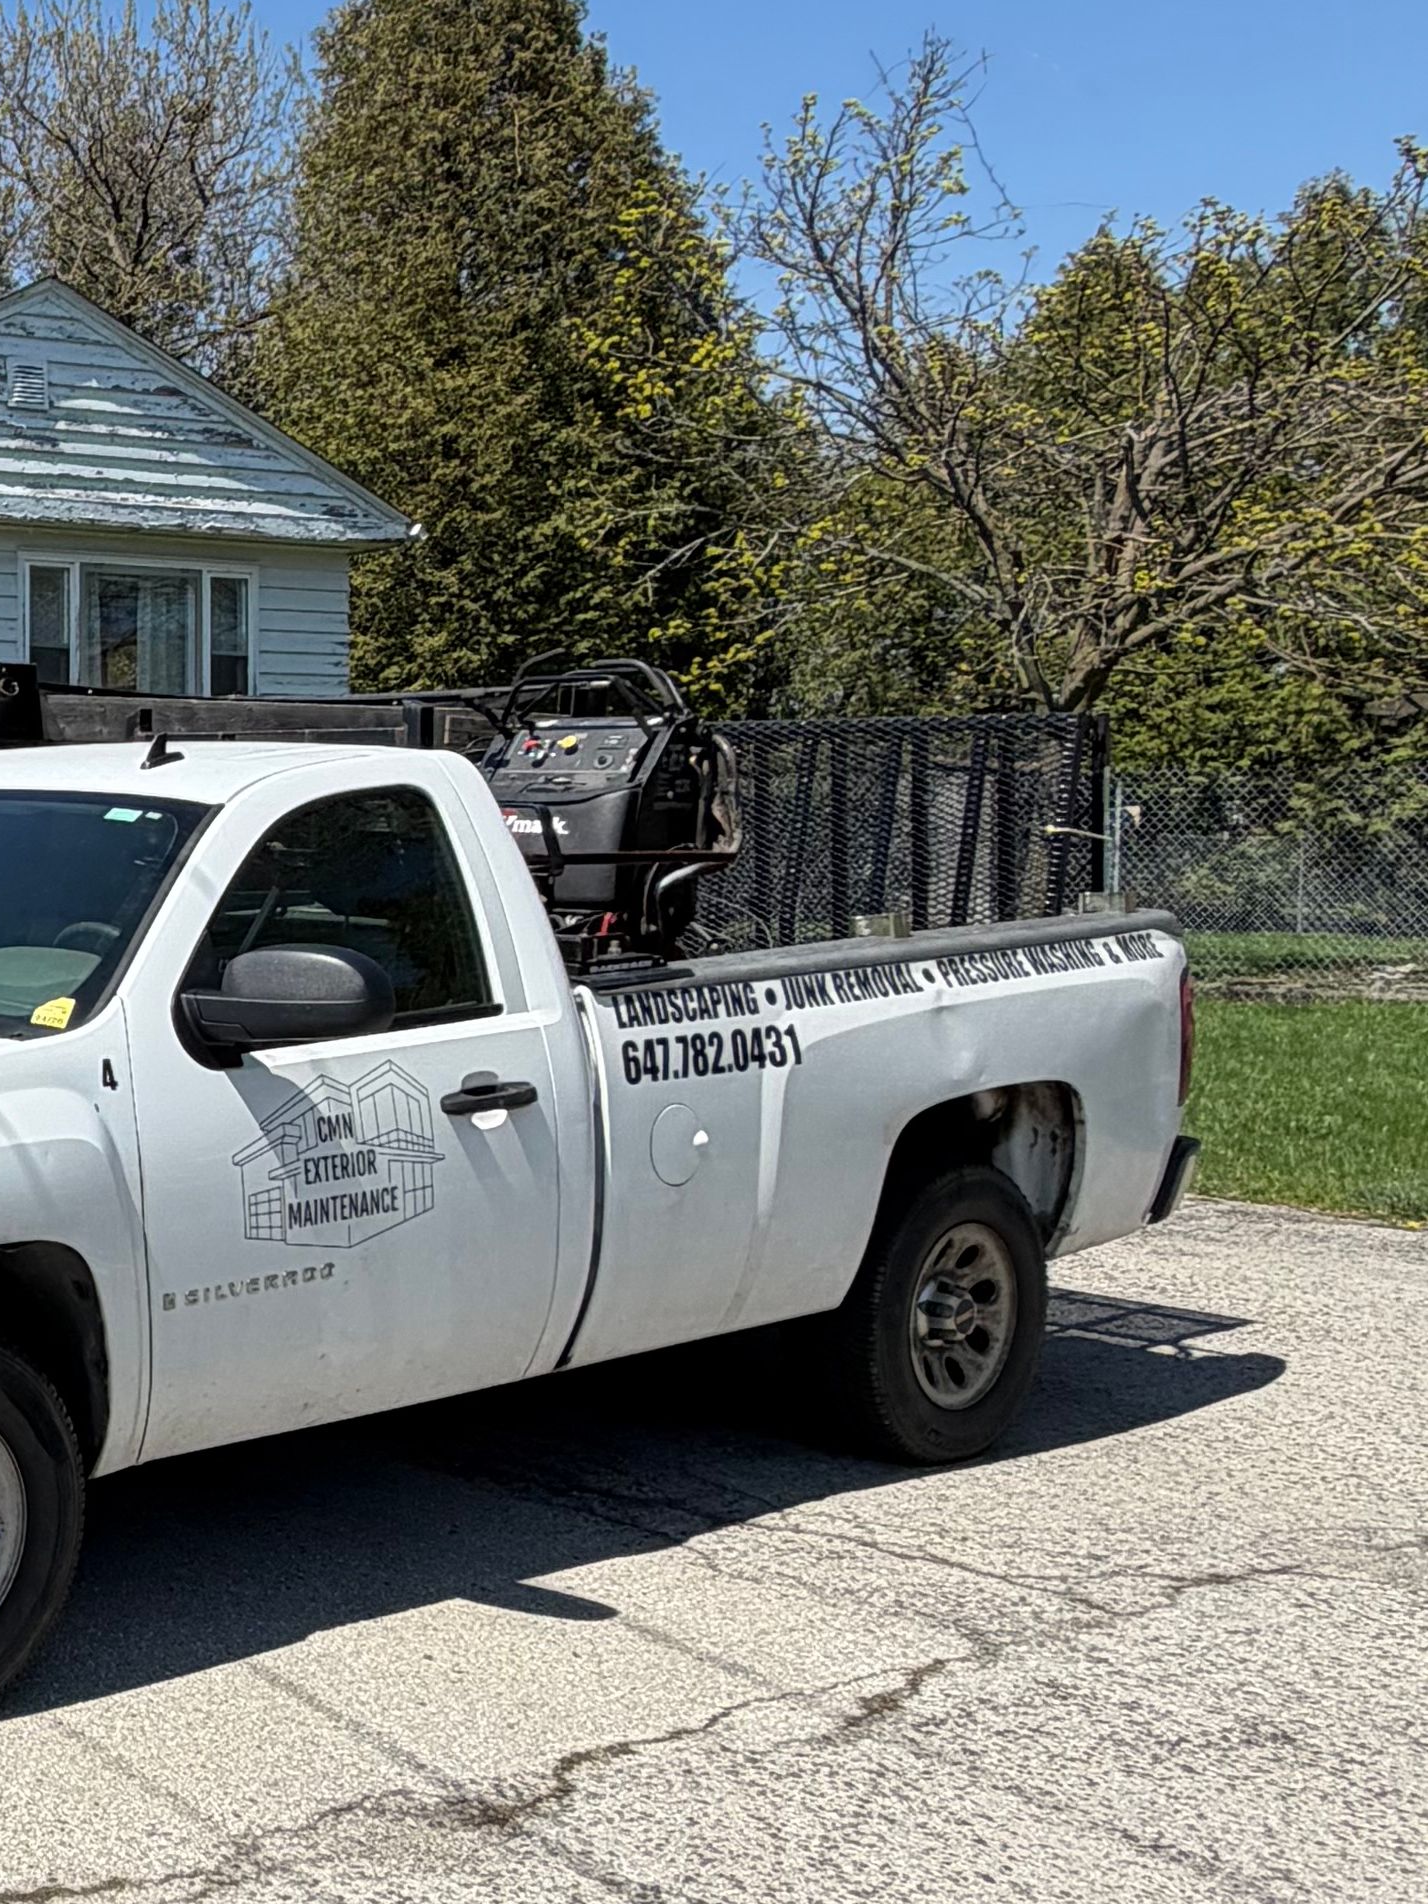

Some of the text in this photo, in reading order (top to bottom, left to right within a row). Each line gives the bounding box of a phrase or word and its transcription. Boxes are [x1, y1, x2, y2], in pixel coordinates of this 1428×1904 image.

[611, 932, 1165, 1029] LANDSCAPING JUNK REMOVAL PRESSURE WASHING & MORE
[102, 1058, 118, 1091] 4
[622, 1024, 803, 1085] 647.782.0431
[316, 1112, 354, 1143] CMN
[304, 1149, 378, 1185] EXTERIOR
[288, 1186, 399, 1230] MAINTENANCE
[184, 1261, 336, 1307] SILVERADO
